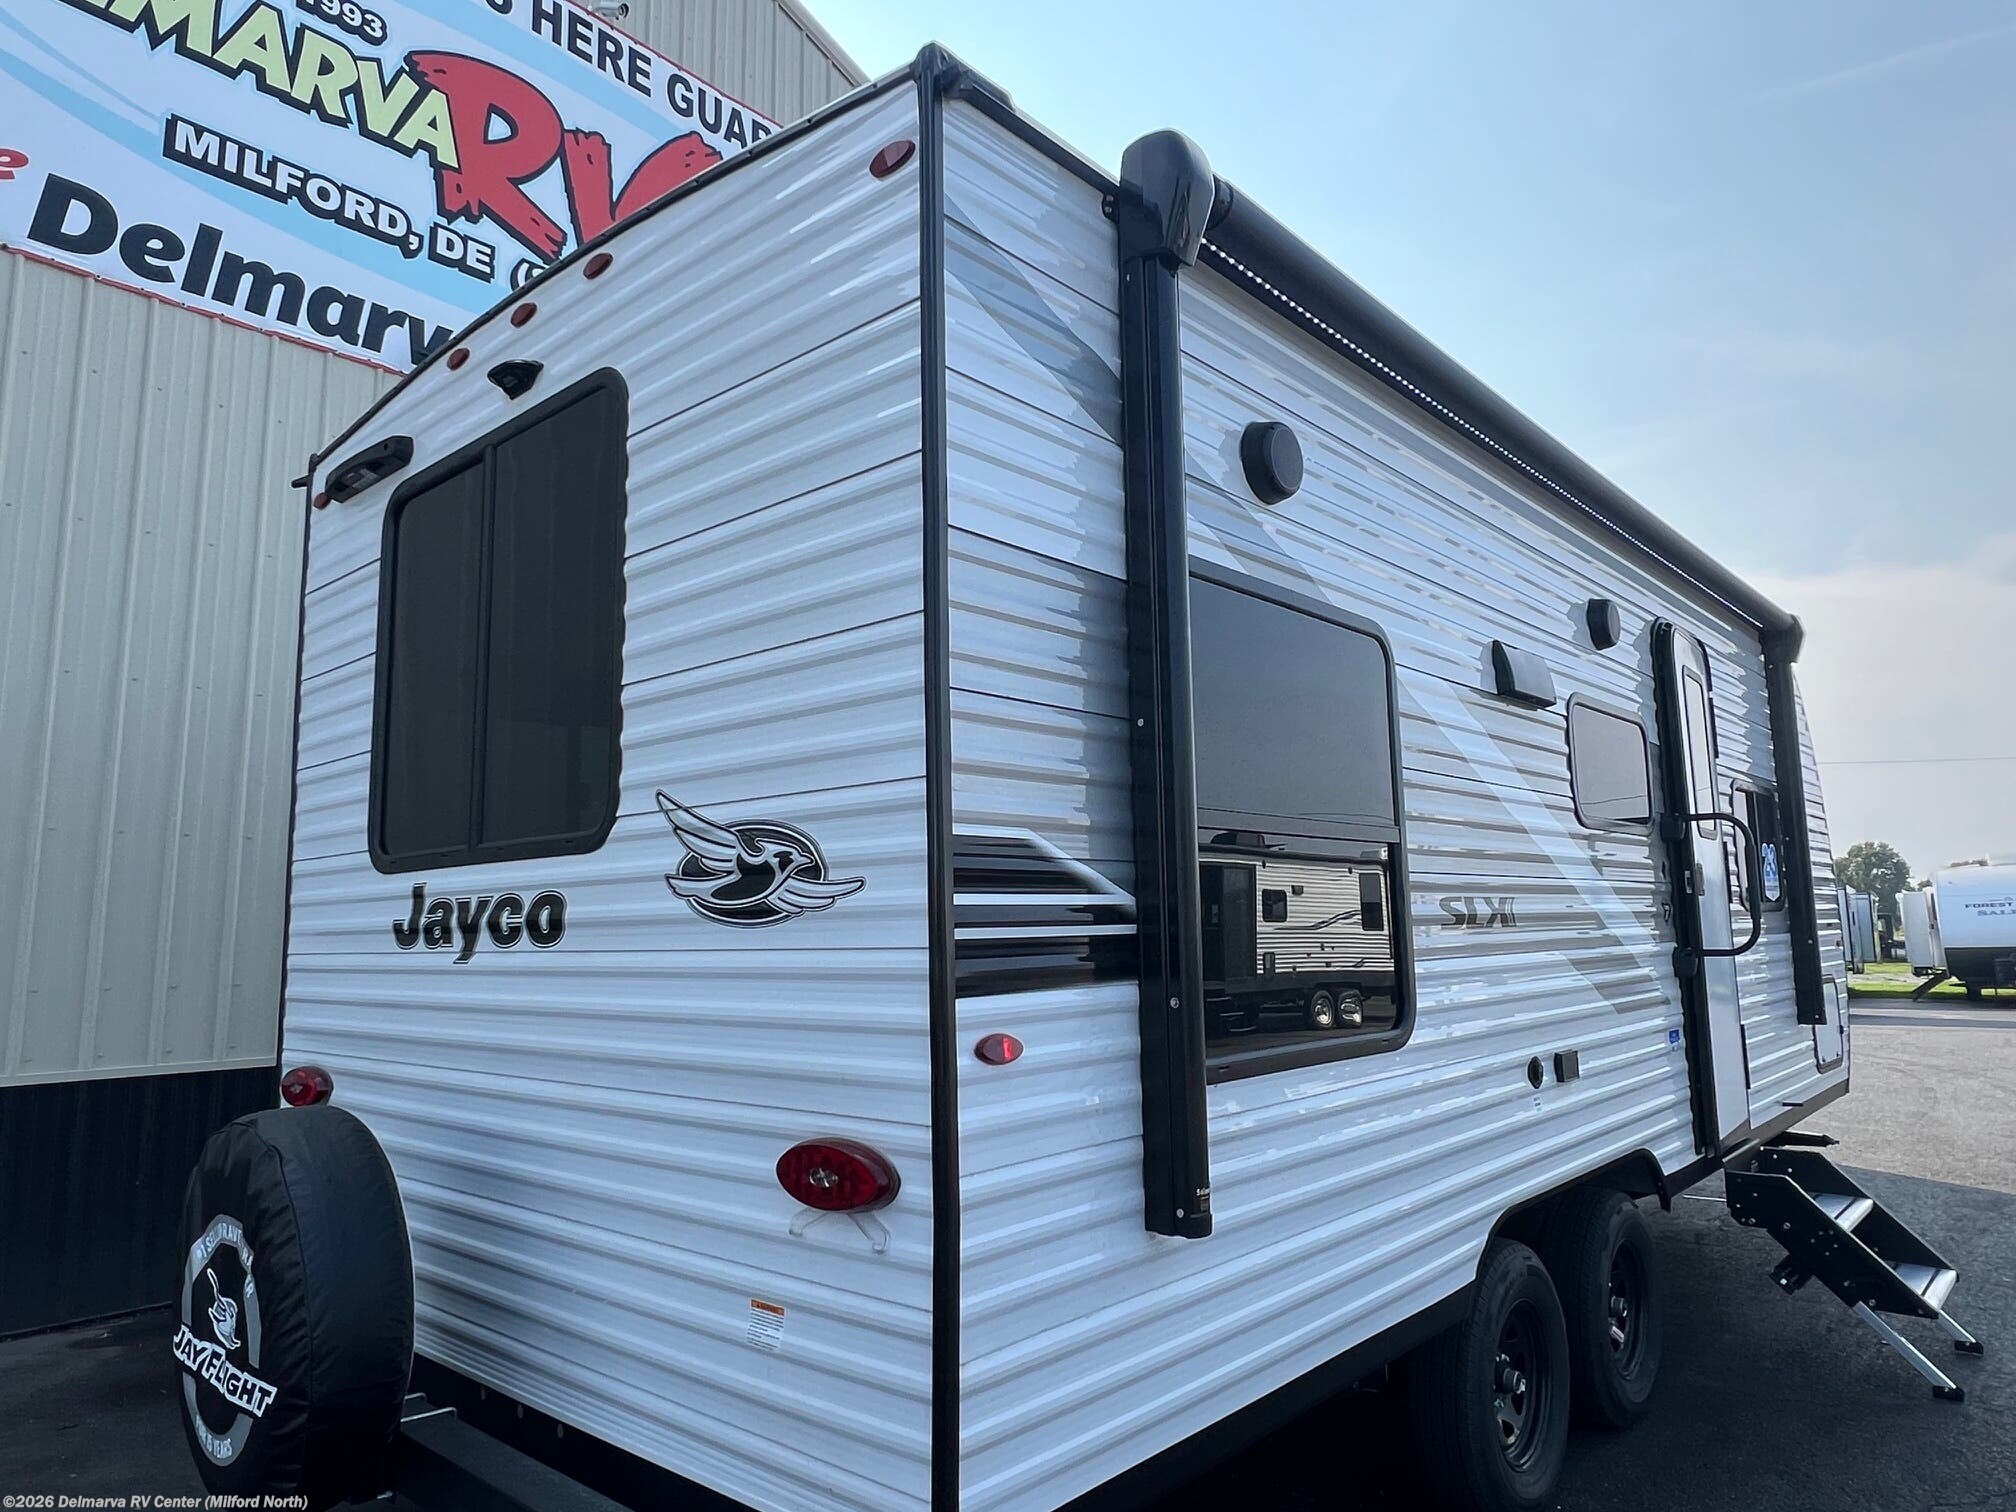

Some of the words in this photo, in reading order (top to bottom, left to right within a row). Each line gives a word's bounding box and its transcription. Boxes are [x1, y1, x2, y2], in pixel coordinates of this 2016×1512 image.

[302, 0, 385, 41] 993
[531, 0, 652, 98] HERE
[403, 49, 724, 262] RV
[170, 117, 423, 254] MILFORD,
[432, 224, 495, 277] DE
[392, 882, 567, 964] Jayco
[1438, 896, 1517, 929] SLX
[1964, 901, 2013, 909] FOREST
